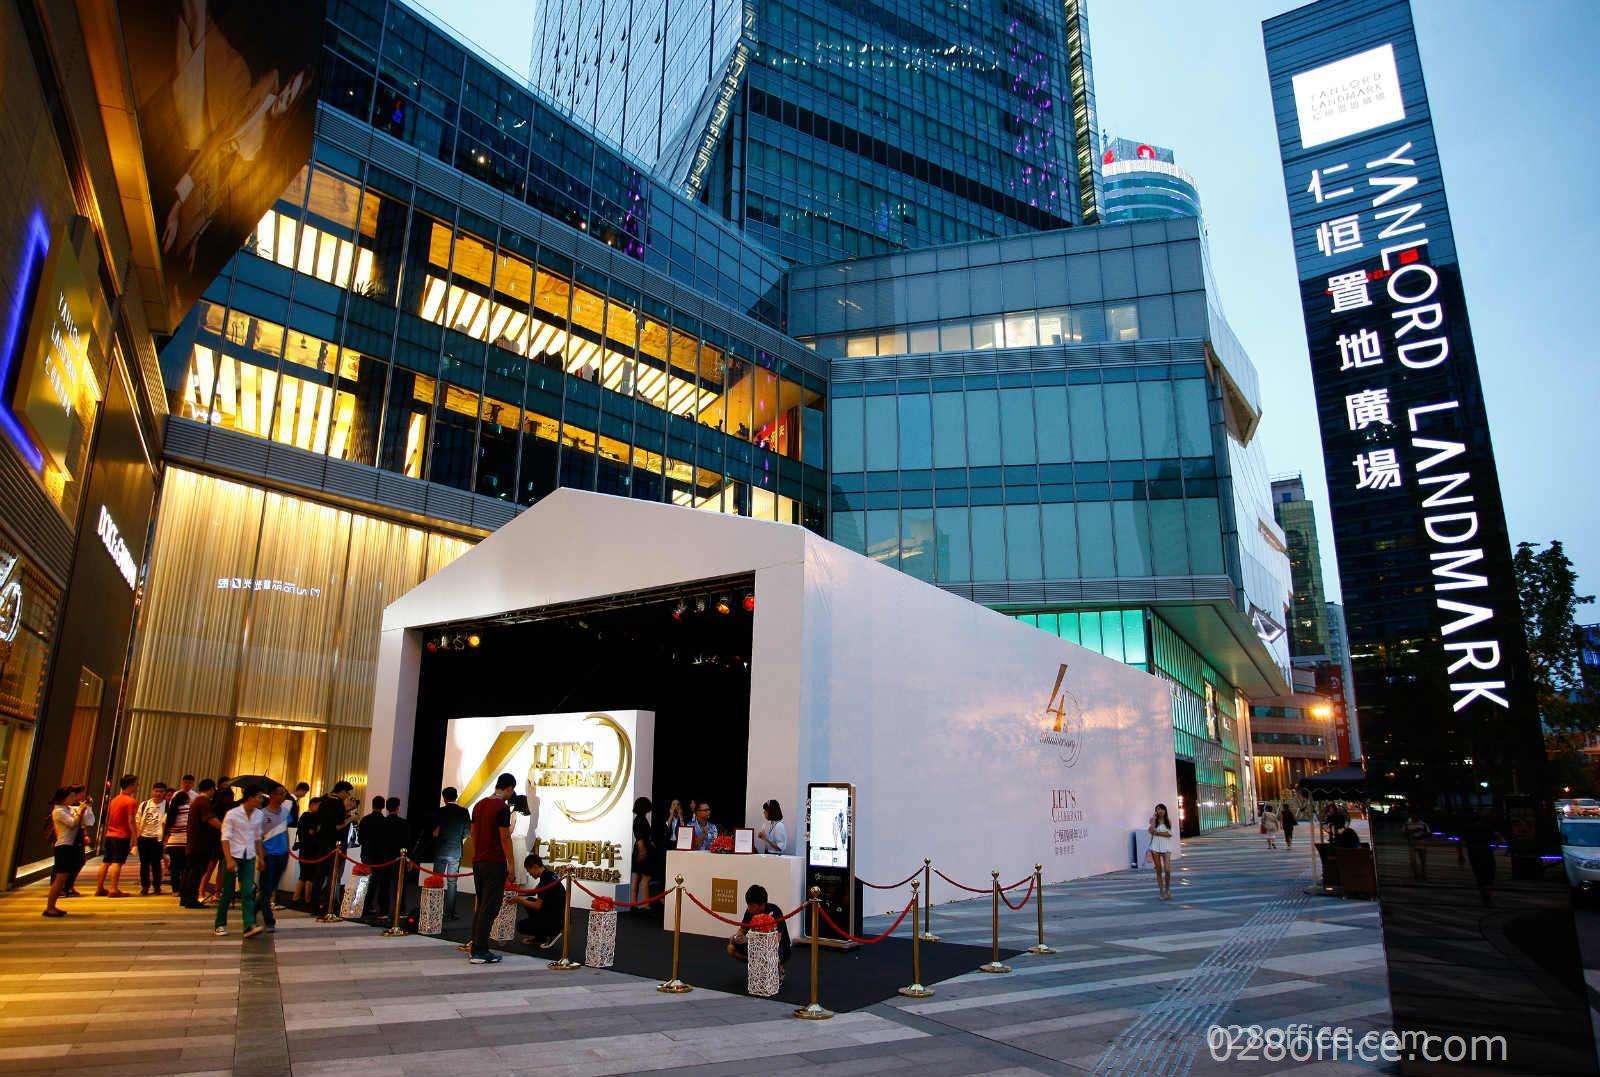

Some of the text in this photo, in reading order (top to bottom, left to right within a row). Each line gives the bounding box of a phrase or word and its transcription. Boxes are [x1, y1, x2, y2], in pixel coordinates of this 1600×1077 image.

[1311, 84, 1382, 112] LANDMARK
[1307, 163, 1402, 490] 仁恒置地廣場
[1366, 142, 1510, 713] YANLORD LANDMARK
[532, 741, 594, 769] LET'S
[1051, 789, 1077, 808] LET'S
